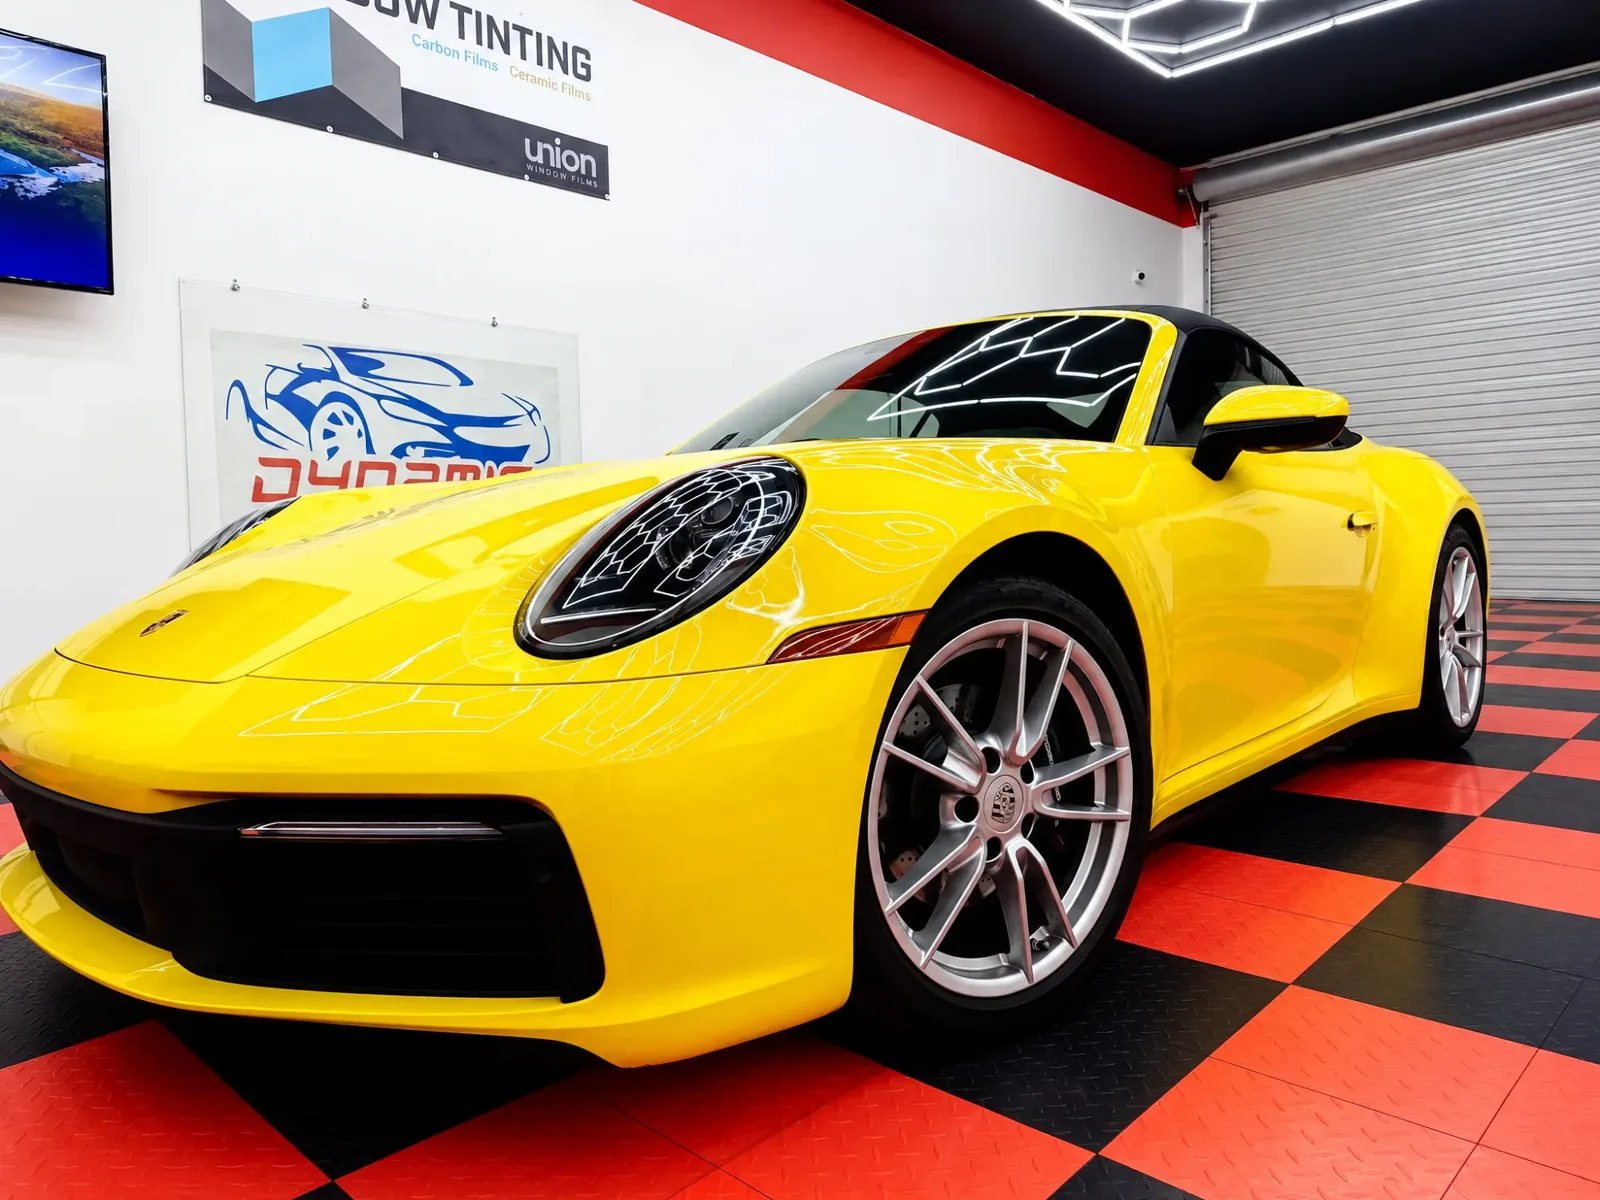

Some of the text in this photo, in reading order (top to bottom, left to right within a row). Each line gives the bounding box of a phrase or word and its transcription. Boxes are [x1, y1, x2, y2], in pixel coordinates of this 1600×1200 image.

[411, 33, 499, 72] Carbon Films
[449, 0, 592, 82] TINTING
[509, 65, 592, 102] Ceramic Films
[524, 137, 597, 178] union
[526, 163, 598, 188] WINDOW FILMS
[251, 457, 534, 503] DYNA
